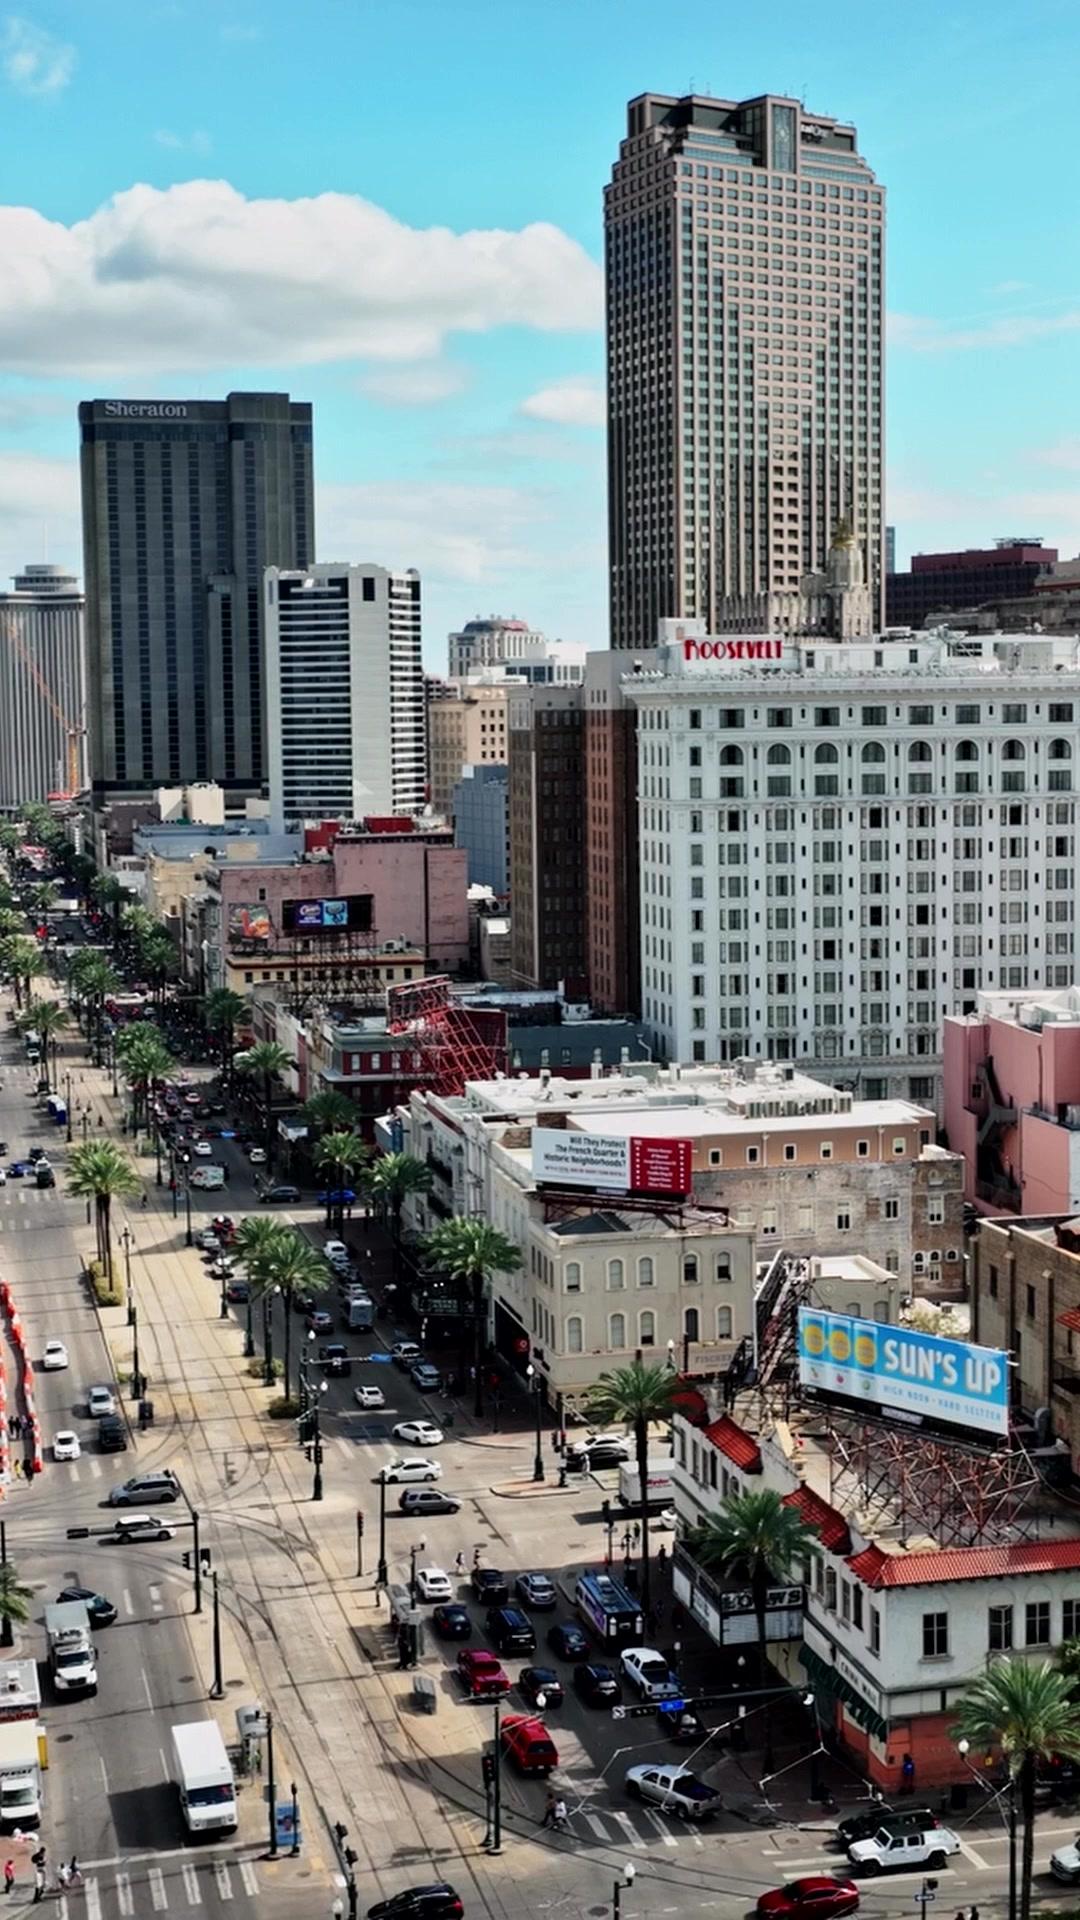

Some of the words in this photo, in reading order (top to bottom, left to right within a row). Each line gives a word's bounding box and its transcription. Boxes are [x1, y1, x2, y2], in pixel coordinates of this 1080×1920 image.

[105, 401, 187, 417] Sheraton
[684, 639, 782, 660] ROOSEVELT
[555, 1144, 567, 1153] The
[568, 1145, 592, 1155] French
[593, 1148, 619, 1157] Quarter
[570, 1136, 582, 1145] Will
[583, 1137, 599, 1147] They
[600, 1138, 626, 1149] Protect
[544, 1153, 570, 1163] Historic
[884, 1339, 958, 1386] SUN'S
[965, 1357, 1001, 1396] UP
[721, 1588, 802, 1612] LOWS
